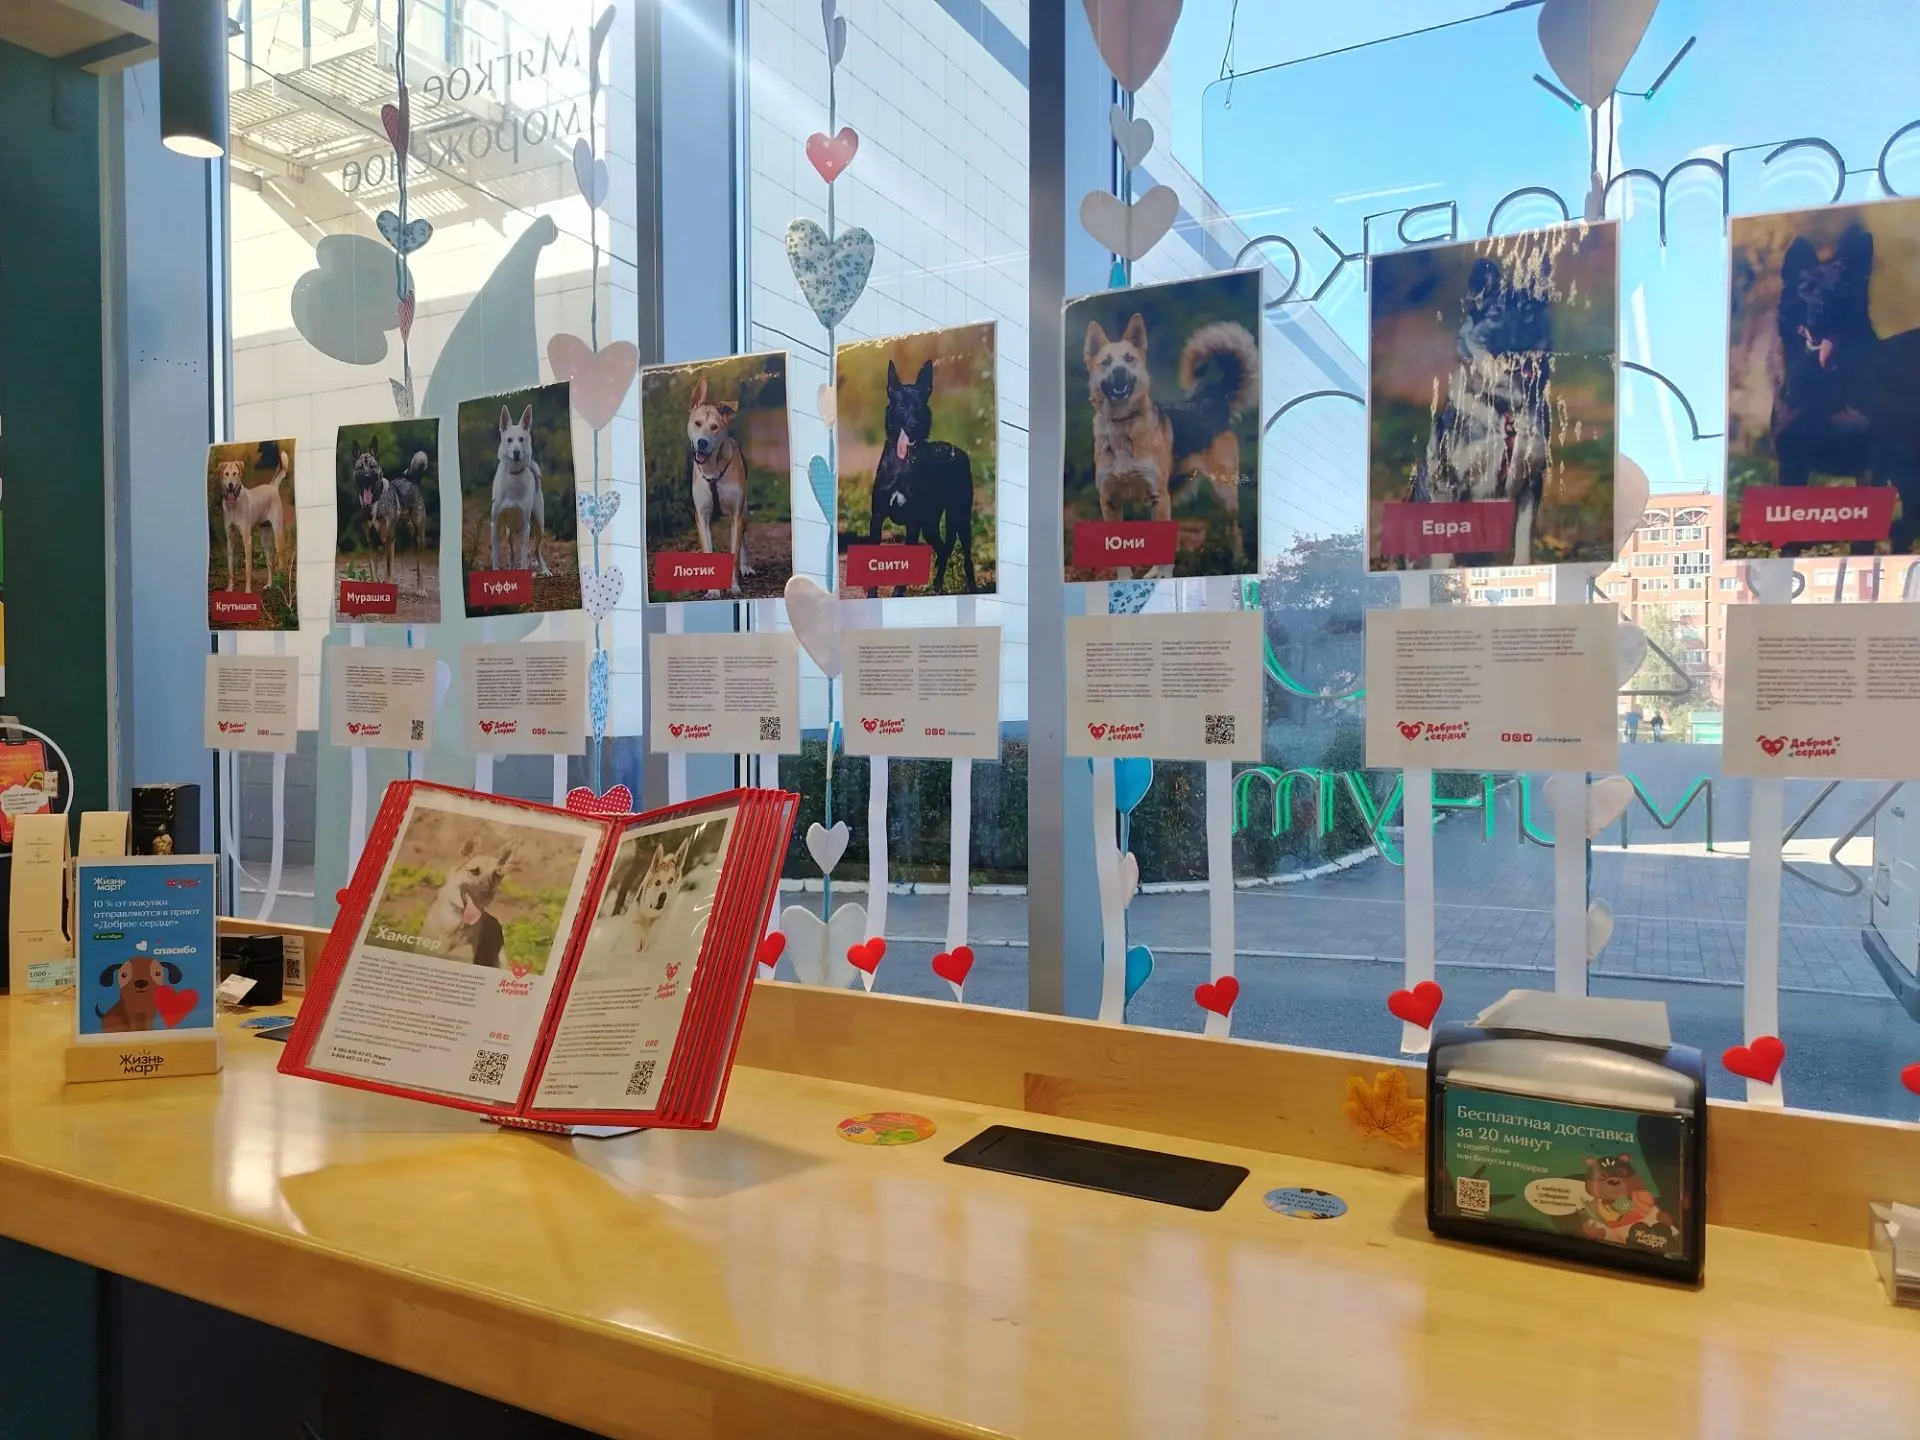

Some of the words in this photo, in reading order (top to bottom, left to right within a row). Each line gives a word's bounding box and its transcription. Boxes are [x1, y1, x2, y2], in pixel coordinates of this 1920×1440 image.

[1765, 504, 1868, 523] Шелдон
[1422, 519, 1472, 538] Евра
[1105, 536, 1145, 551] Юми
[673, 564, 715, 578] Лютик
[868, 558, 909, 572] Свити
[483, 581, 518, 596] Гуффи
[346, 591, 391, 605] Мурашка
[215, 601, 258, 613] Крутышка
[1109, 724, 1139, 734] Доброе
[1426, 722, 1462, 733] Доброе
[1112, 733, 1142, 741] сердце
[1430, 732, 1466, 742] сердце
[1790, 736, 1832, 749] Доброе
[1795, 748, 1836, 759] сердце
[93, 877, 126, 887] Жизнь
[97, 884, 122, 892] март
[93, 900, 104, 908] 10
[129, 900, 168, 909] покупки
[93, 910, 161, 919] отправляются
[170, 908, 201, 917] приют
[93, 921, 138, 930] «Доброе
[139, 920, 180, 929] сердце»
[375, 926, 442, 952] Хамстер
[153, 945, 197, 955] спасибо
[120, 1054, 164, 1066] Жизнь
[124, 1063, 162, 1076] март
[1457, 1105, 1551, 1132] Бесплатная
[1554, 1123, 1635, 1143] доставка
[1457, 1127, 1473, 1139] за
[1478, 1127, 1499, 1142] 20
[1503, 1134, 1553, 1152] минут
[1456, 1153, 1472, 1161] или
[1473, 1154, 1506, 1166] бонусы
[1513, 1160, 1549, 1174] подарок
